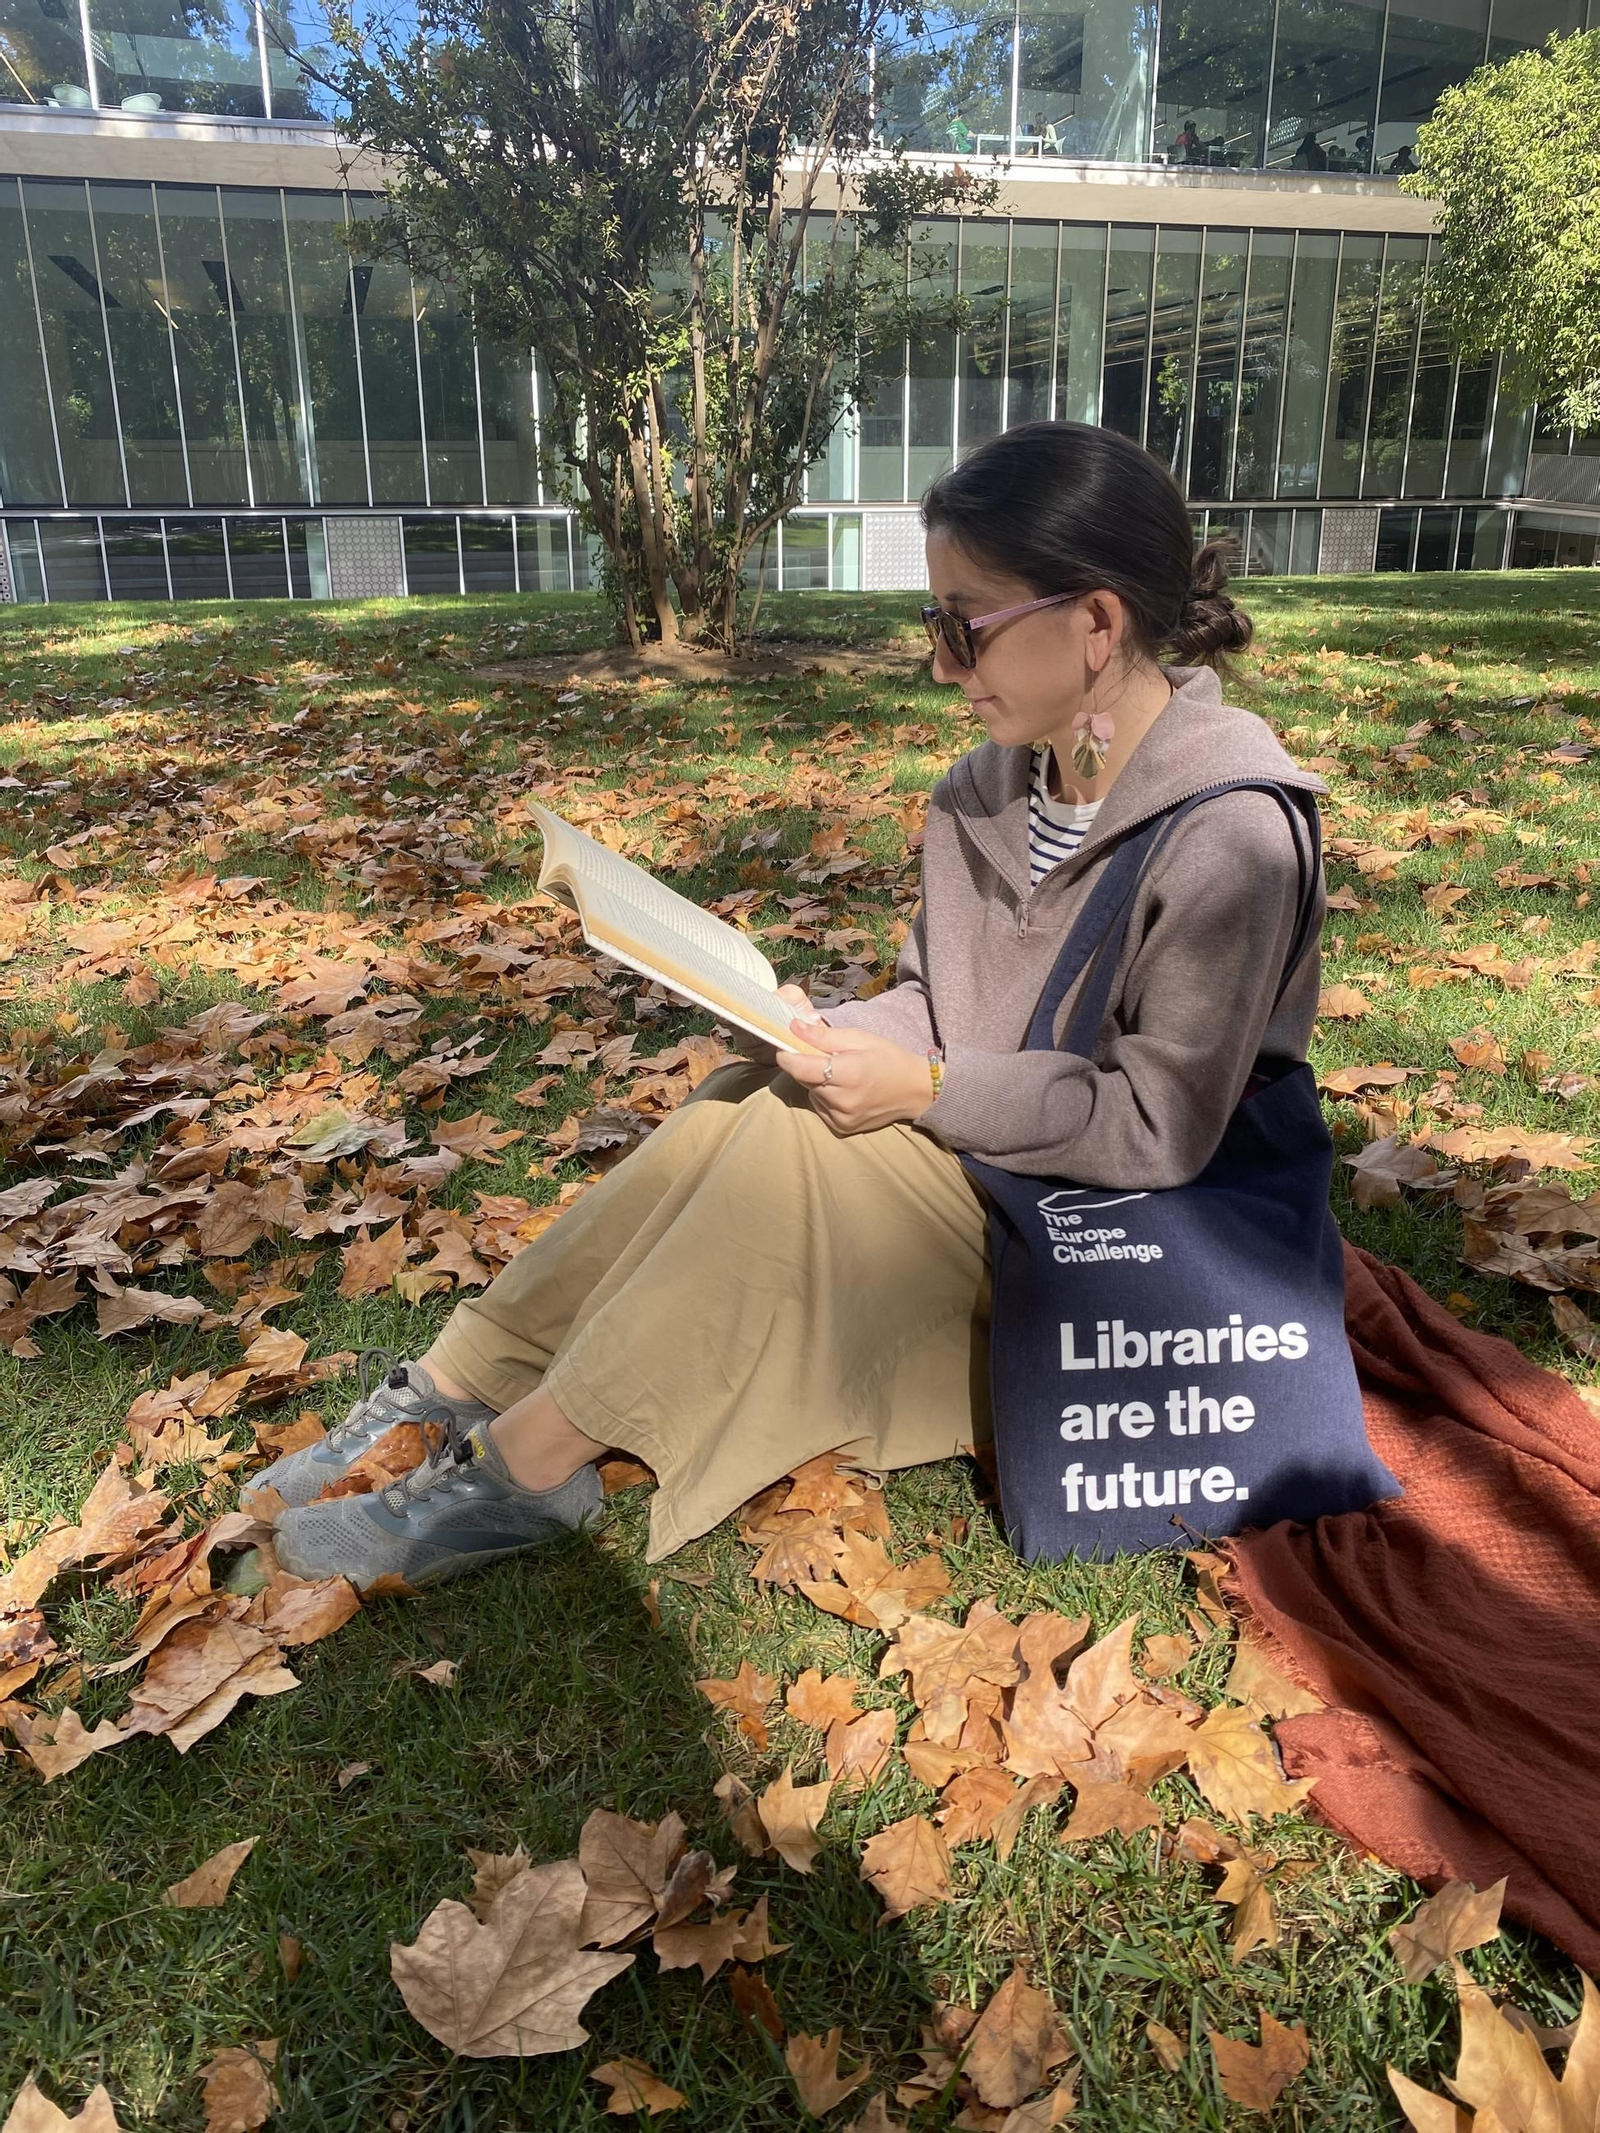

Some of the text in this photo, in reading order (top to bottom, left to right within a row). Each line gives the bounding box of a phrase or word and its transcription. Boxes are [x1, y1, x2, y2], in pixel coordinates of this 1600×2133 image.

[1039, 1210, 1082, 1227] The
[1046, 1226, 1127, 1243] Europe
[1053, 1243, 1163, 1263] Challenge
[1060, 1313, 1310, 1371] Libraries
[1059, 1385, 1256, 1442] are the
[1061, 1462, 1249, 1513] future.
